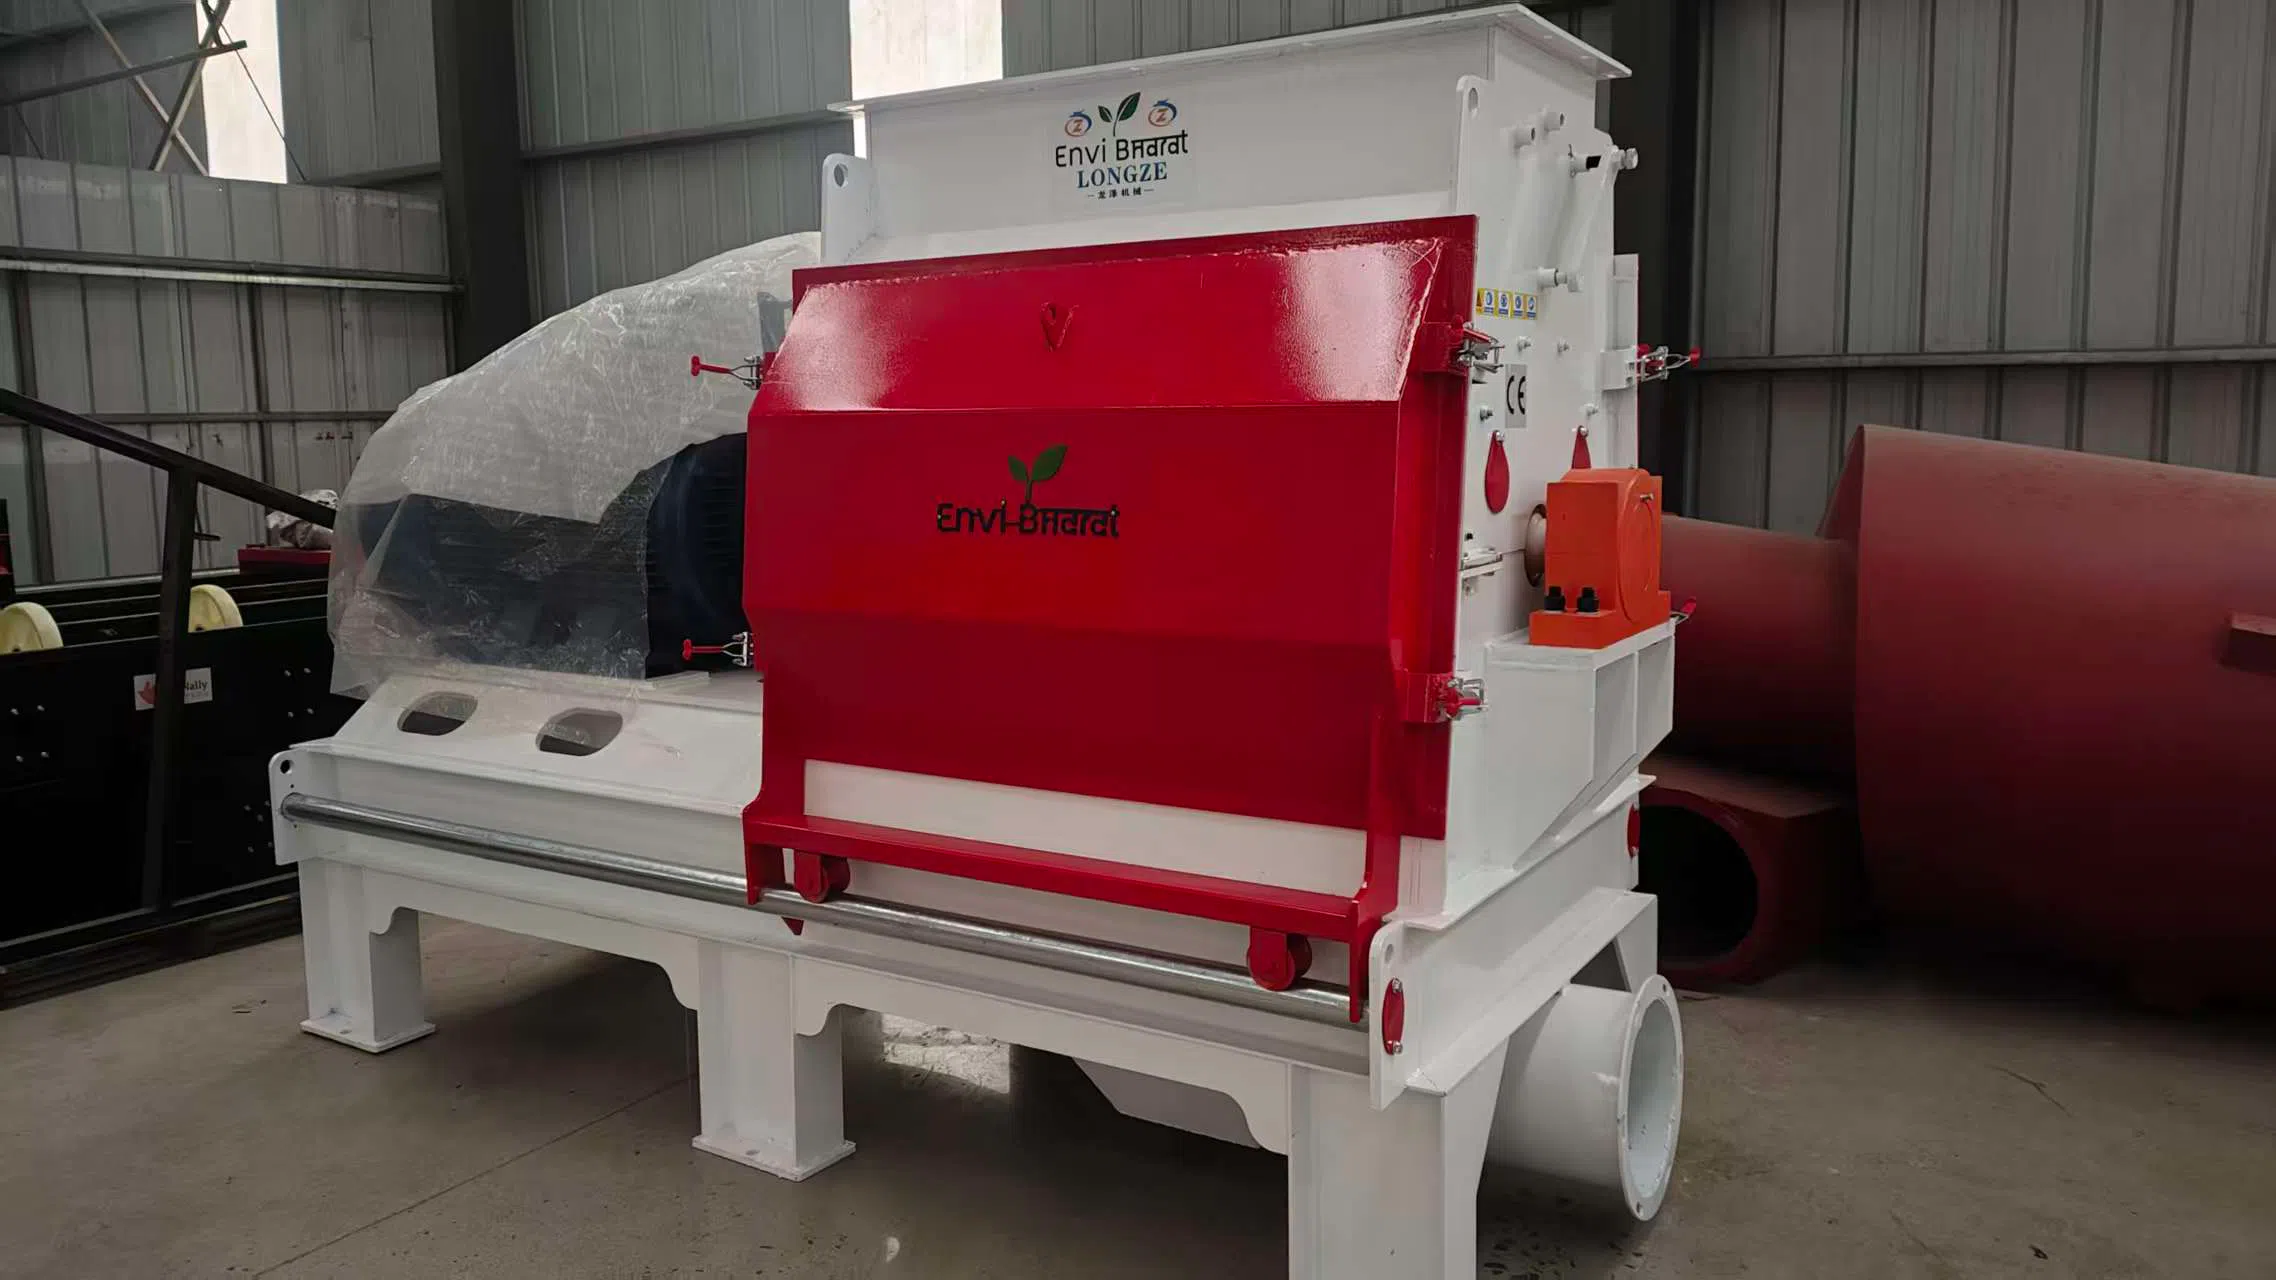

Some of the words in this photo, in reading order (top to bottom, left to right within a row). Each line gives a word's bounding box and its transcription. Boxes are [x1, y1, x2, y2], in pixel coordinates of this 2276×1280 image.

[1055, 138, 1107, 168] Envi
[1077, 161, 1168, 189] LONGZE
[1506, 375, 1526, 415] CE
